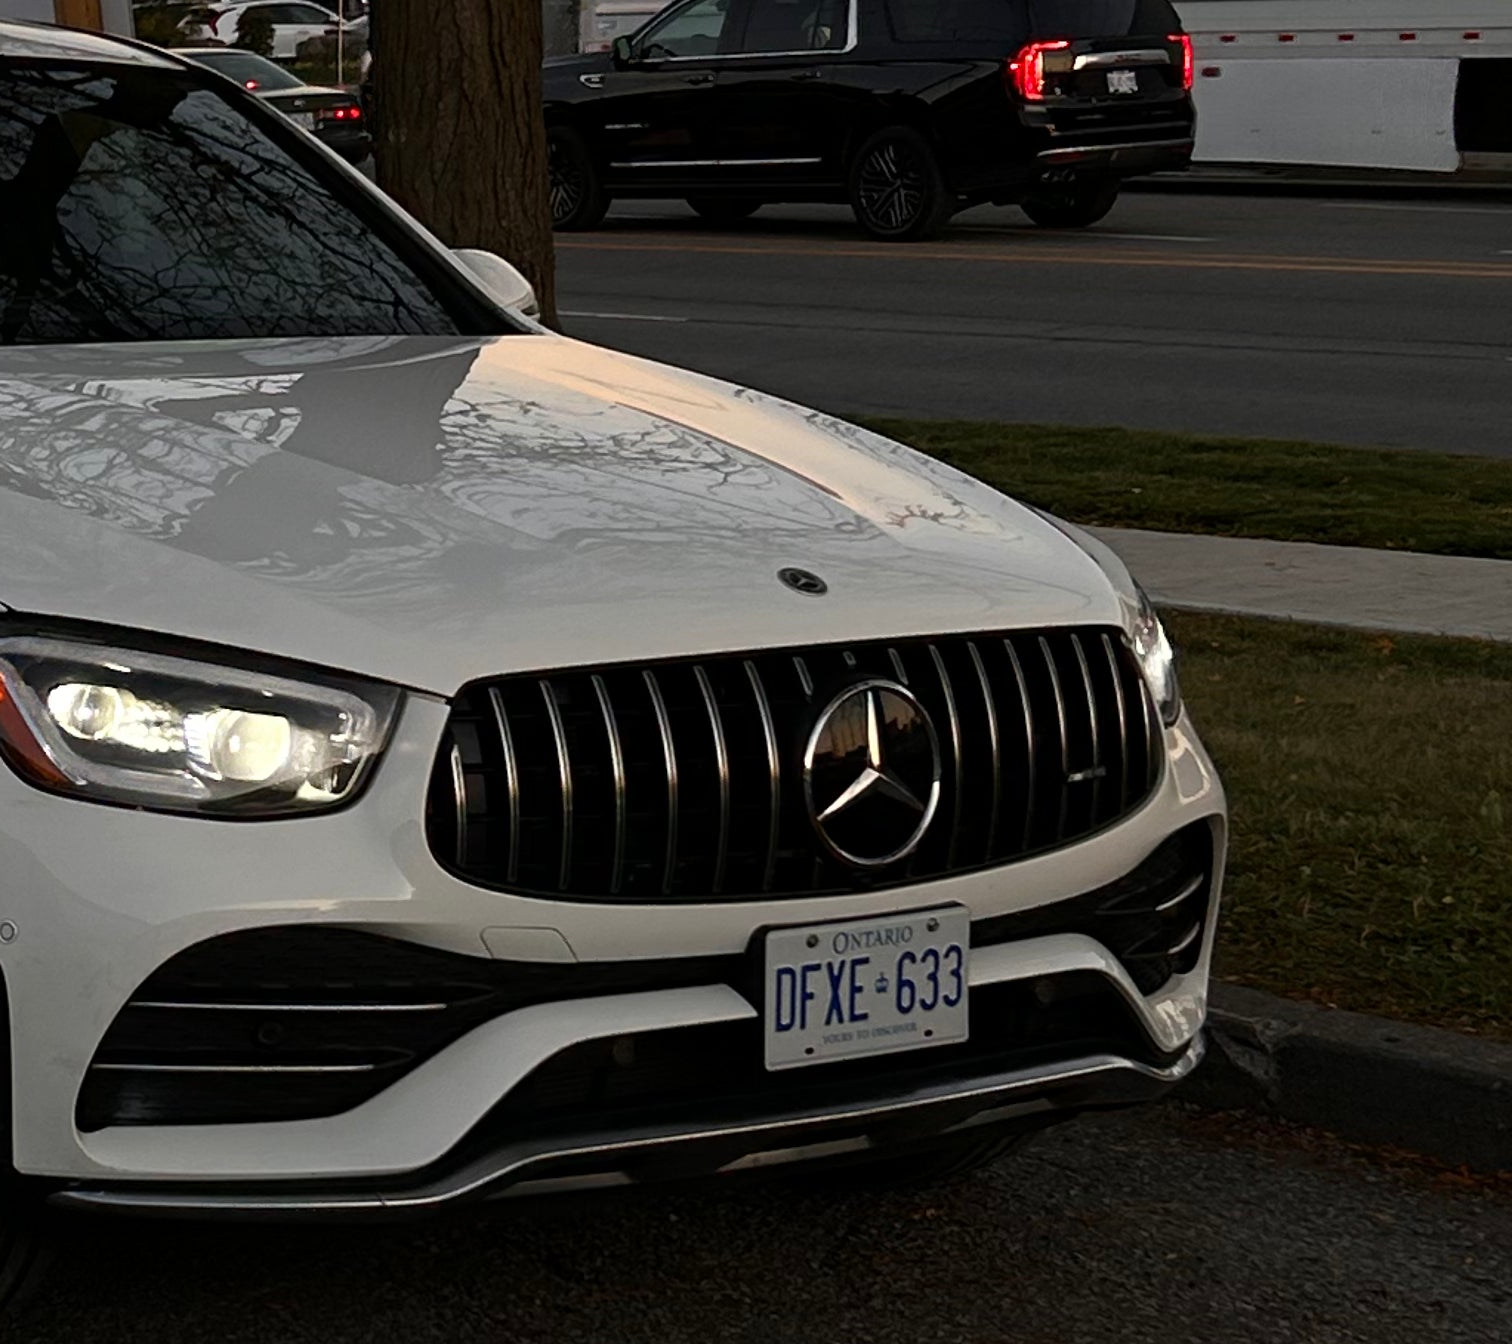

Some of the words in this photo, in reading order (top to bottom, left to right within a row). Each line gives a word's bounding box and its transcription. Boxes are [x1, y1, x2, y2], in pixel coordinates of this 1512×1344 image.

[832, 926, 914, 954] ONTARIO
[775, 957, 870, 1032] DFXE
[896, 944, 963, 1014] 633
